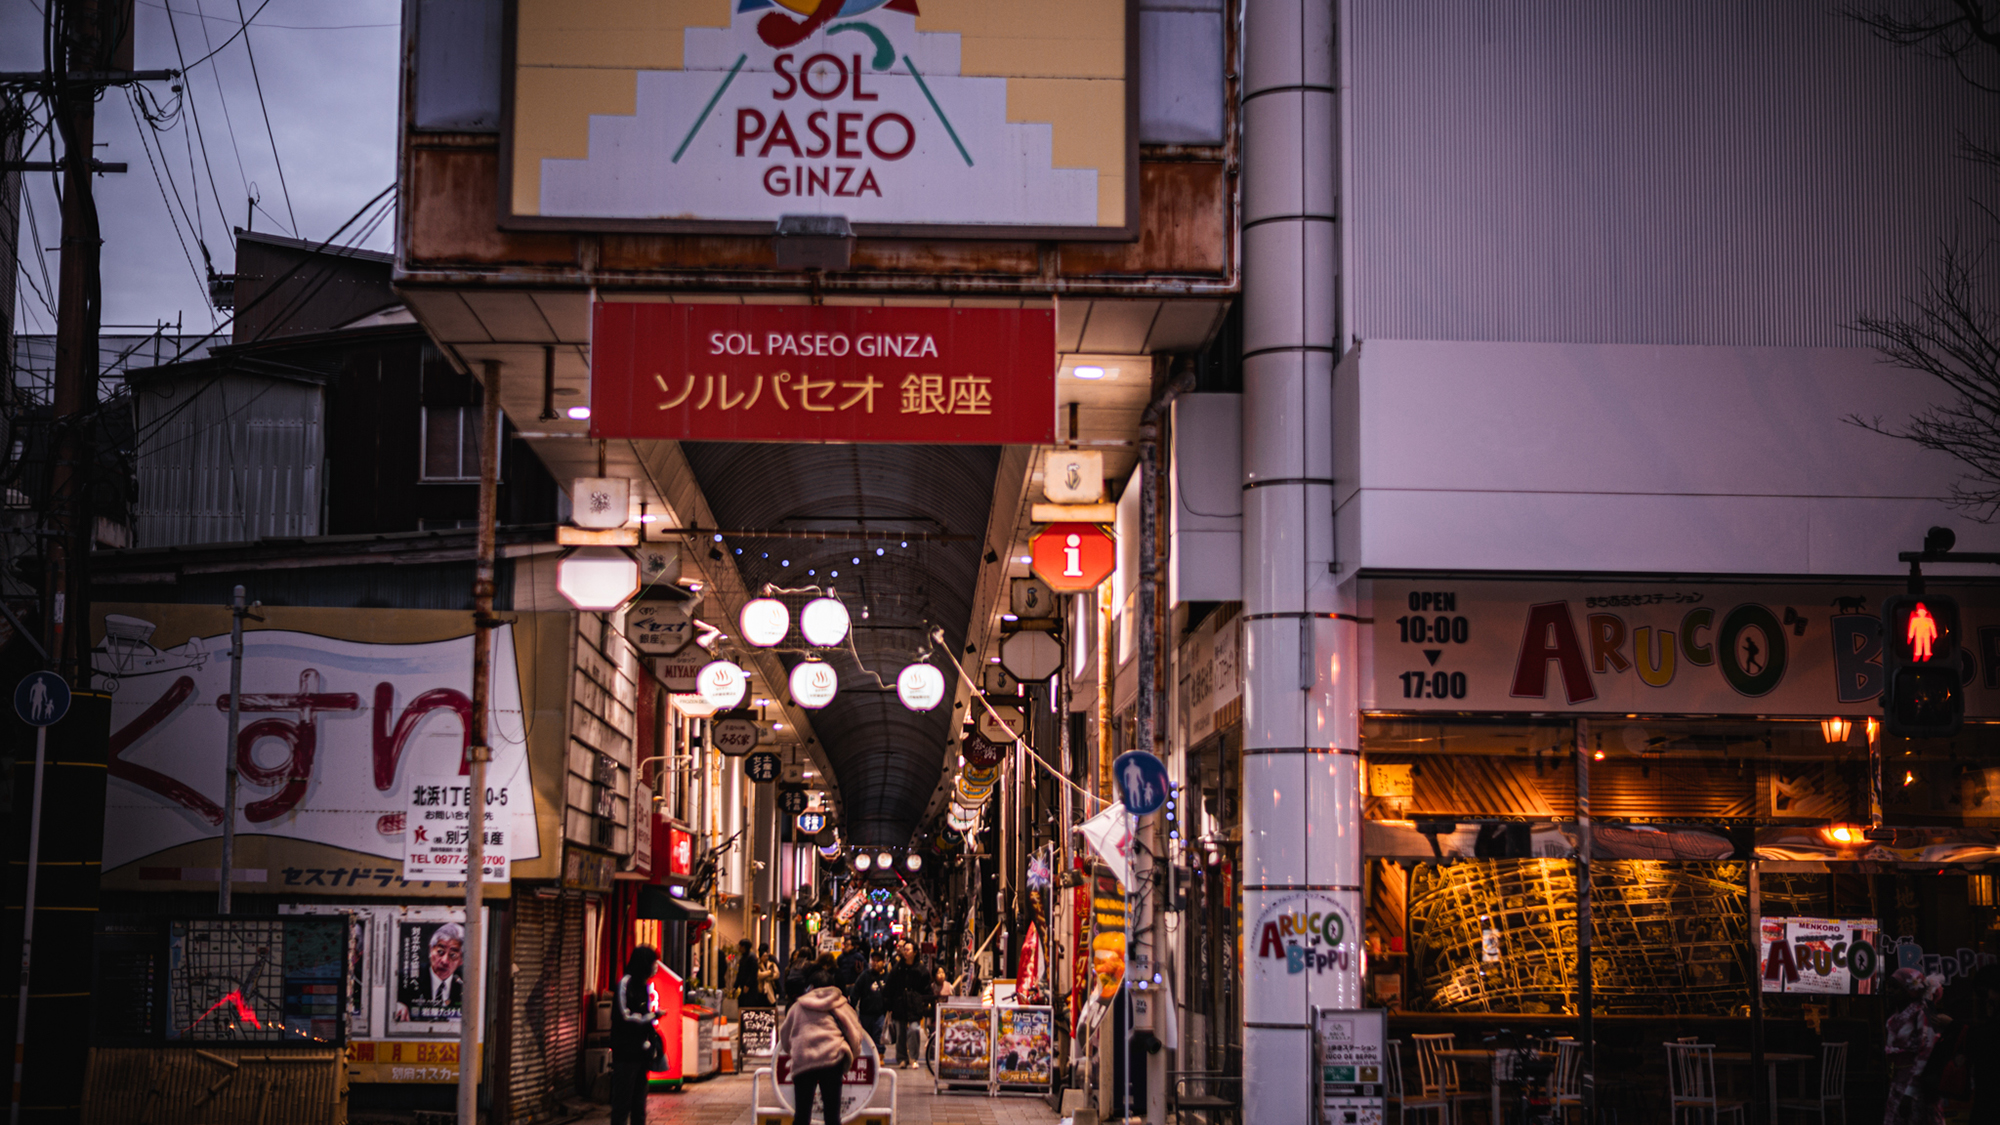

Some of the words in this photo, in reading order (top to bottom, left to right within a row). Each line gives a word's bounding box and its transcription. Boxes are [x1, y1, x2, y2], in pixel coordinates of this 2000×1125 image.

[772, 53, 879, 101] SOL
[736, 109, 916, 162] PASEO
[762, 165, 882, 198] GINZA
[710, 332, 761, 357] SOL
[767, 332, 850, 358] PASEO
[856, 334, 938, 360] GINZA
[654, 371, 884, 413] ソルパセオ
[900, 374, 992, 416] 銀座
[1408, 591, 1456, 612] OPEN
[1585, 592, 1704, 608] まちあるきステーション
[1397, 616, 1469, 644] 10:00
[1510, 599, 1789, 705] ARUCO
[1783, 606, 1808, 636] DE
[1399, 671, 1467, 700] 17:00
[108, 668, 473, 834] くすり
[413, 785, 508, 807] 北浜1丁目0-5
[425, 810, 494, 821] お問い合わ先
[410, 854, 431, 864] TEL
[281, 867, 431, 888] セスナドラッ
[1259, 912, 1344, 959] ARUCO
[1798, 923, 1840, 932] MENKORO
[1286, 945, 1348, 974] BEPPU
[1764, 939, 1877, 984] ARUCO
[392, 1044, 402, 1061] 月
